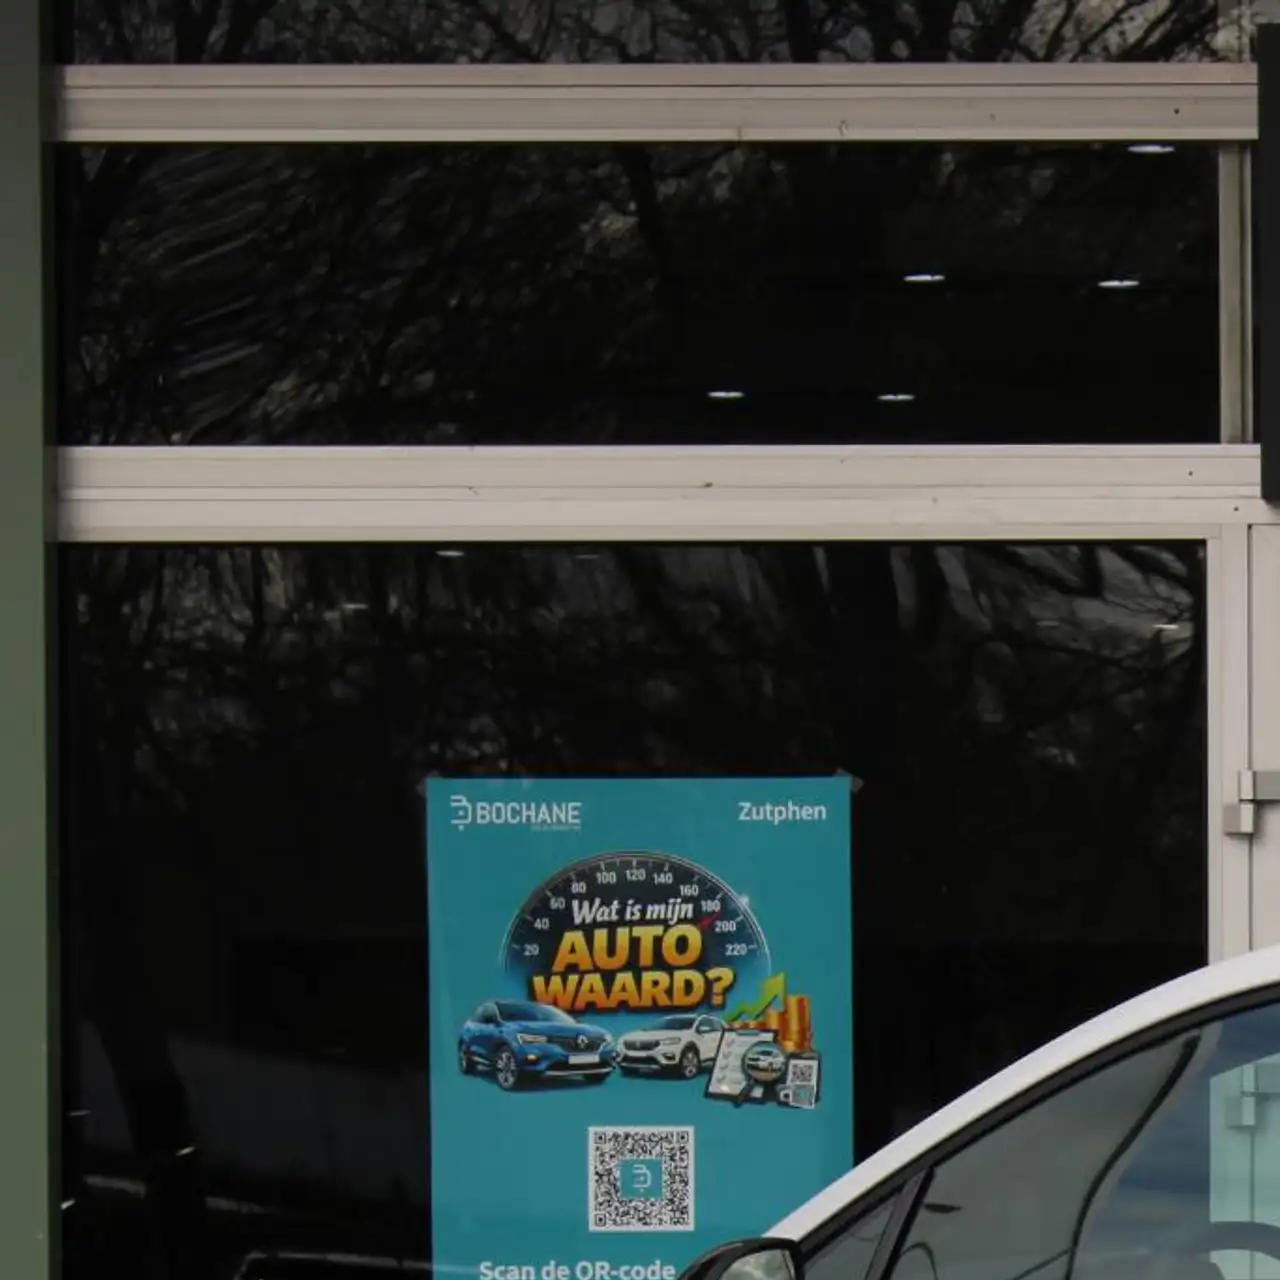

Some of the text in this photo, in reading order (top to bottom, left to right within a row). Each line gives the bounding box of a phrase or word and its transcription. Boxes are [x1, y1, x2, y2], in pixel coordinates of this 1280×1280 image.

[476, 802, 582, 824] BOCHANE
[738, 800, 827, 825] Zutphen
[596, 872, 616, 884] 100
[626, 869, 646, 881] 120
[653, 873, 673, 884] 140
[680, 885, 699, 896] 160
[572, 897, 694, 925] Wat is mijn
[534, 918, 550, 930] 40
[714, 921, 736, 932] 200
[523, 944, 539, 956] 20
[552, 924, 702, 972] AUTO
[725, 944, 748, 956] 220
[533, 967, 734, 1011] WAARD?
[541, 1260, 570, 1280] de
